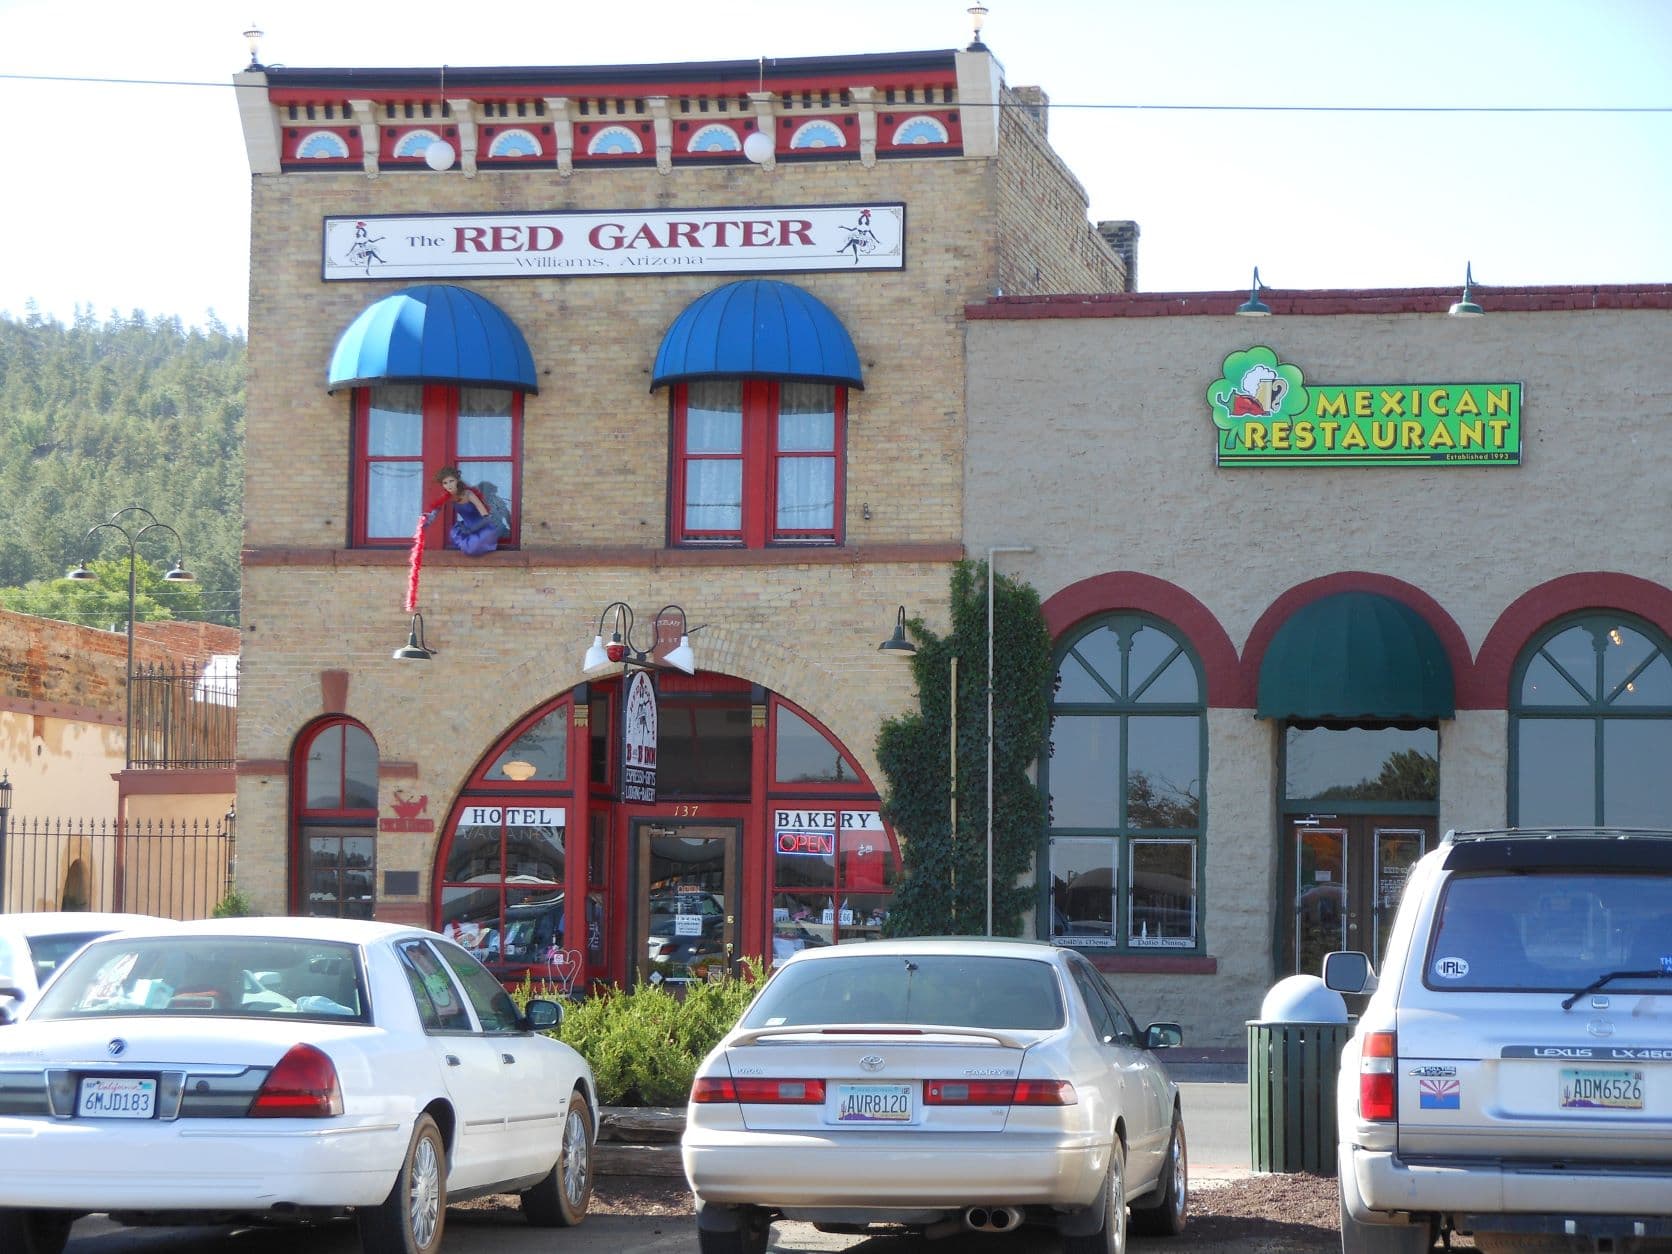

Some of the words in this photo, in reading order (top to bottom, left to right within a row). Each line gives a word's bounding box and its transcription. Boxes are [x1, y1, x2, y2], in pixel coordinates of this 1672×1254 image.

[406, 235, 446, 247] The
[452, 226, 564, 254] RED
[588, 219, 816, 251] GARTER
[620, 255, 704, 267] Arizona
[1316, 388, 1511, 418] MEXICAN
[1244, 419, 1511, 450] RESTAURANT
[1446, 453, 1489, 461] Established
[472, 808, 552, 825] HOTEL
[674, 805, 699, 817] 137
[777, 812, 871, 828] BAKERY
[779, 834, 833, 853] OPEN
[1137, 938, 1159, 946] Patio
[1161, 938, 1187, 947] Dining
[1442, 961, 1464, 974] IRL
[1534, 1048, 1593, 1057] LEXUS
[1612, 1049, 1635, 1058] LX
[1573, 1078, 1642, 1100] ADM6526
[85, 1092, 150, 1111] 6MJD183
[847, 1094, 908, 1114] AVR8120
